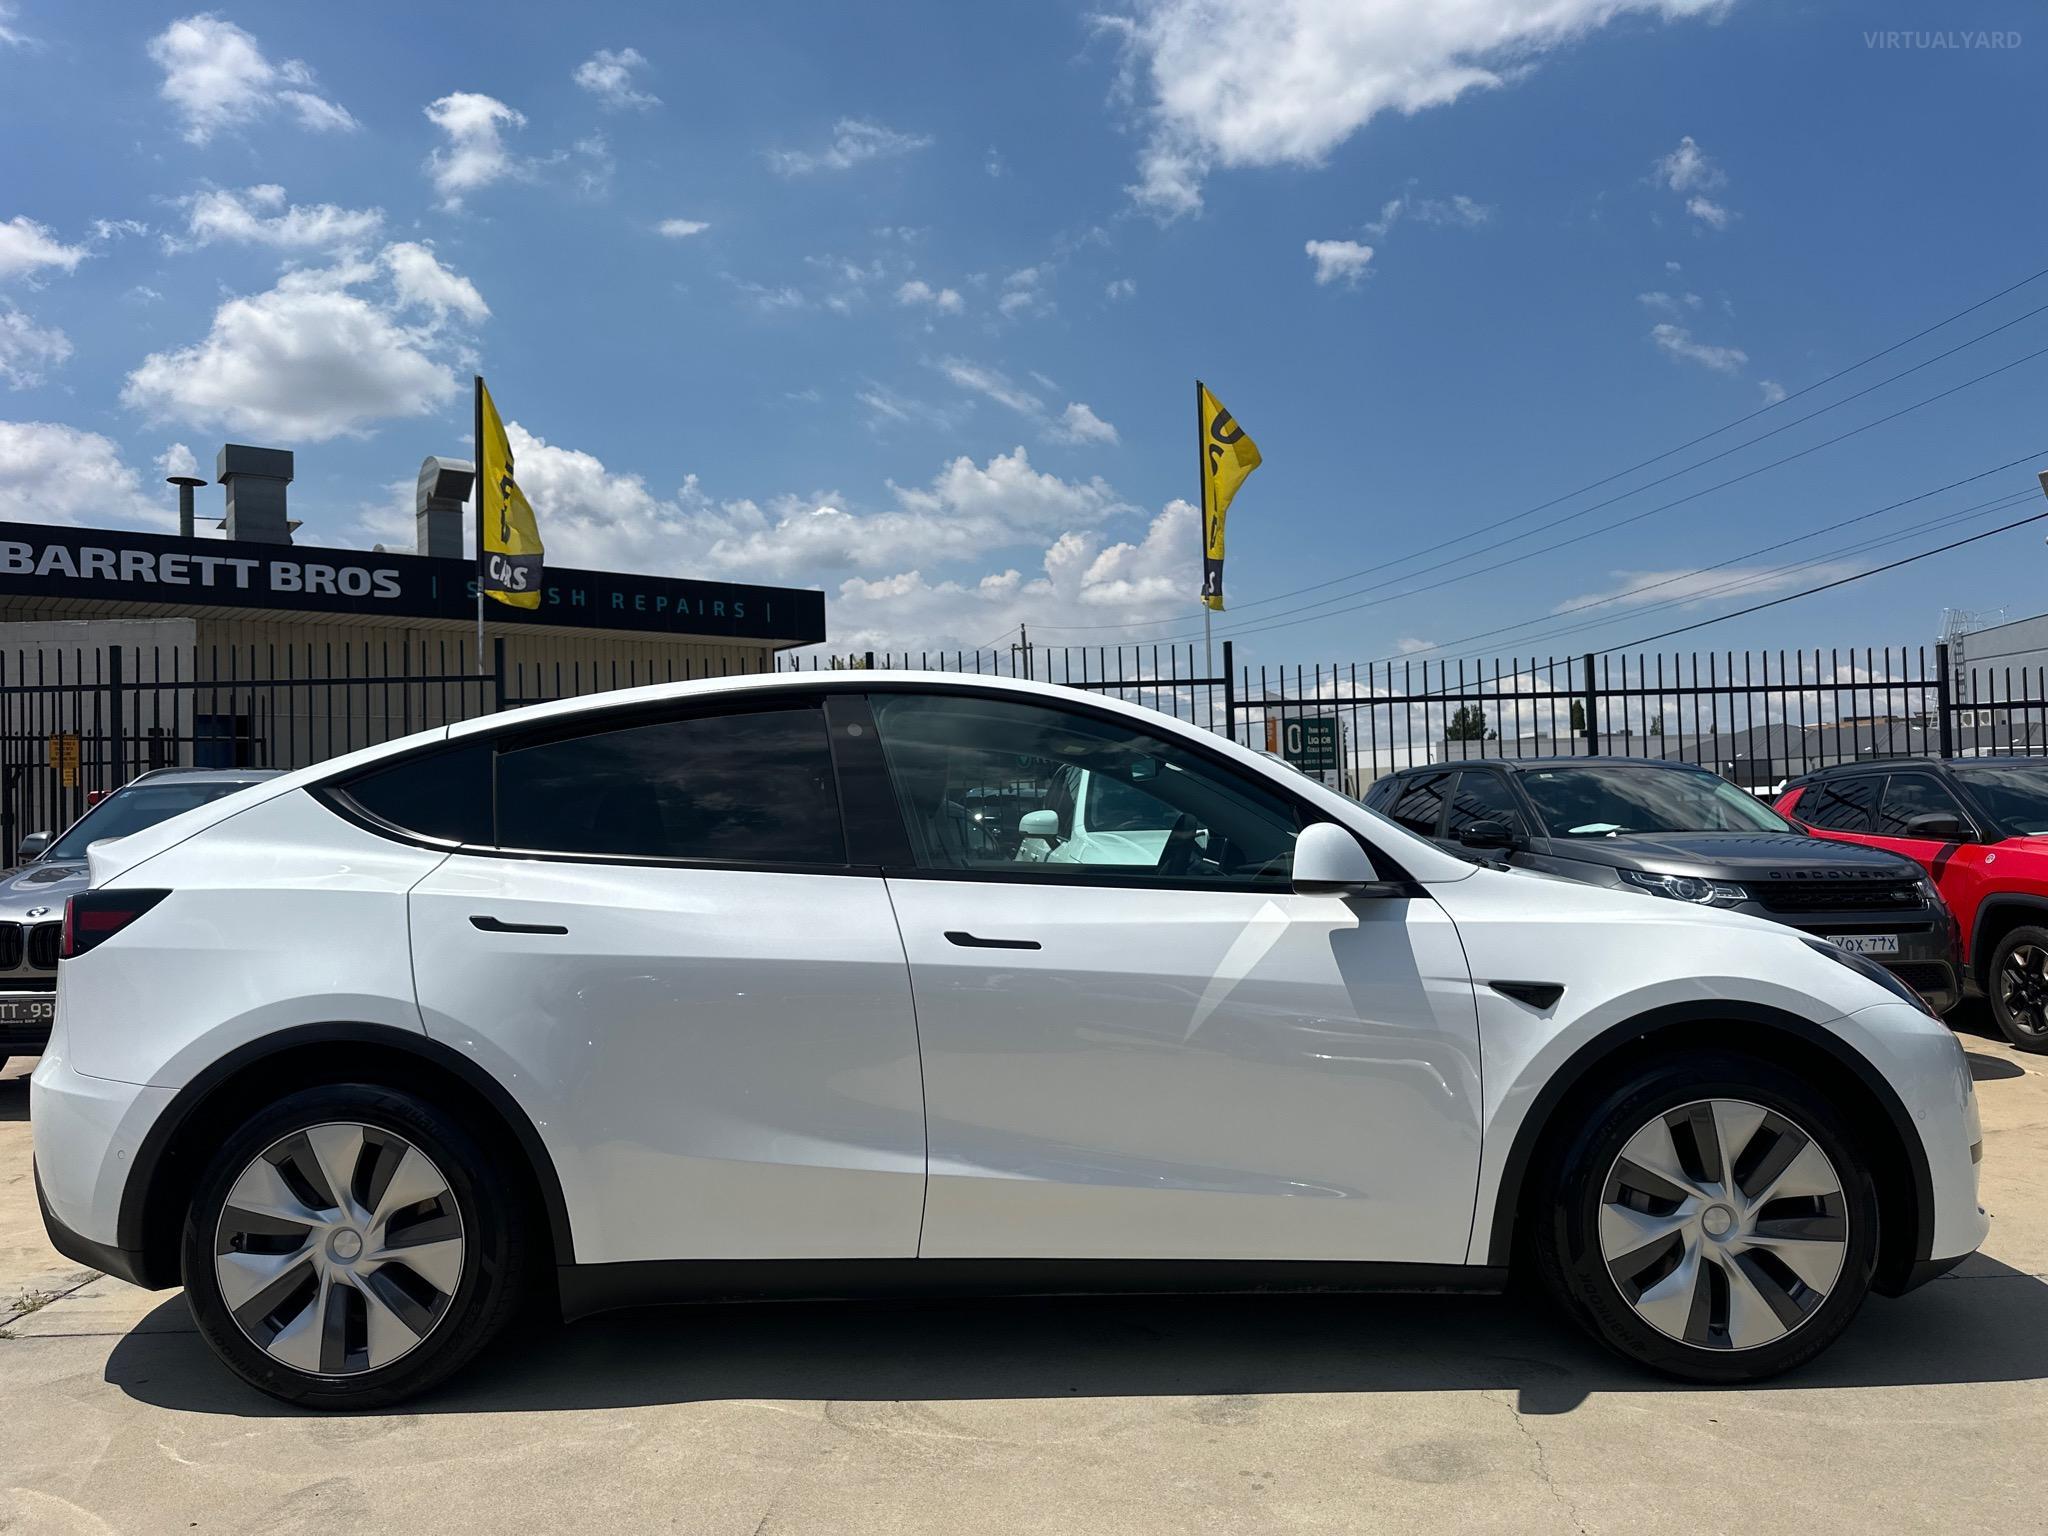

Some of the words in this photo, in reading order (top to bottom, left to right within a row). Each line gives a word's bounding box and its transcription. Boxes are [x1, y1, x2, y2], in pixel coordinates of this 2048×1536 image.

[0, 541, 260, 589] BARRETT
[269, 560, 402, 599] BROS
[489, 555, 530, 591] CARS
[467, 580, 586, 607] SSH
[612, 591, 745, 618] REPAIRS
[1769, 871, 1898, 880] DISCOVERY
